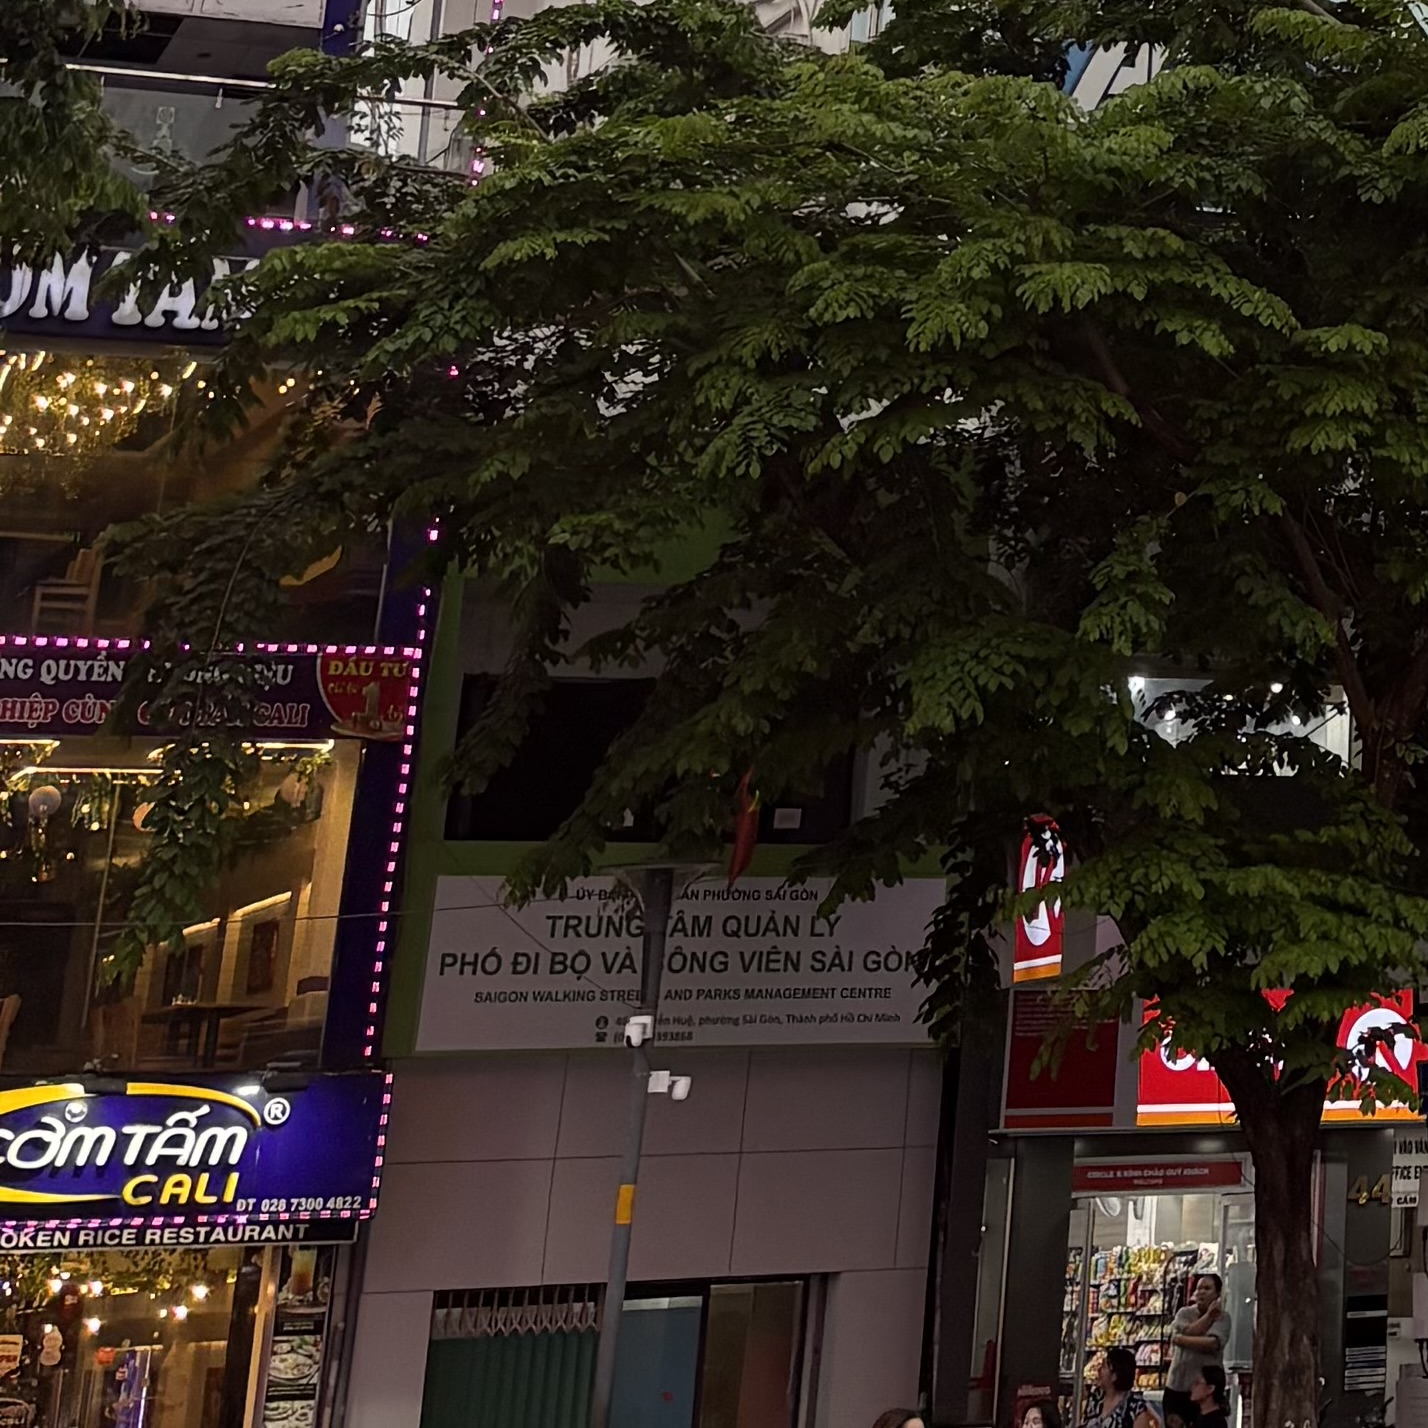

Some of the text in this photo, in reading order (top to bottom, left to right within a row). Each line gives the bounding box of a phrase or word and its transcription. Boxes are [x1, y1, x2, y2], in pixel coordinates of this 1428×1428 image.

[545, 914, 646, 940] TRUNG
[666, 909, 714, 939] ÂM
[721, 909, 801, 939] QUẢN
[438, 944, 855, 982] PHỐ ĐI BỘ VÀ ÔNG VIÊN SÀI
[473, 987, 892, 1004] SAIGON WALKING AND PARKS MANAGEMENT CENTRE
[120, 1103, 249, 1168] TẤM
[120, 1171, 241, 1206] CALI
[259, 1197, 288, 1213] 028
[288, 1196, 324, 1212] 7300
[325, 1195, 363, 1211] 4822
[76, 1227, 130, 1247] RICE
[143, 1222, 311, 1246] RESTAURANT
